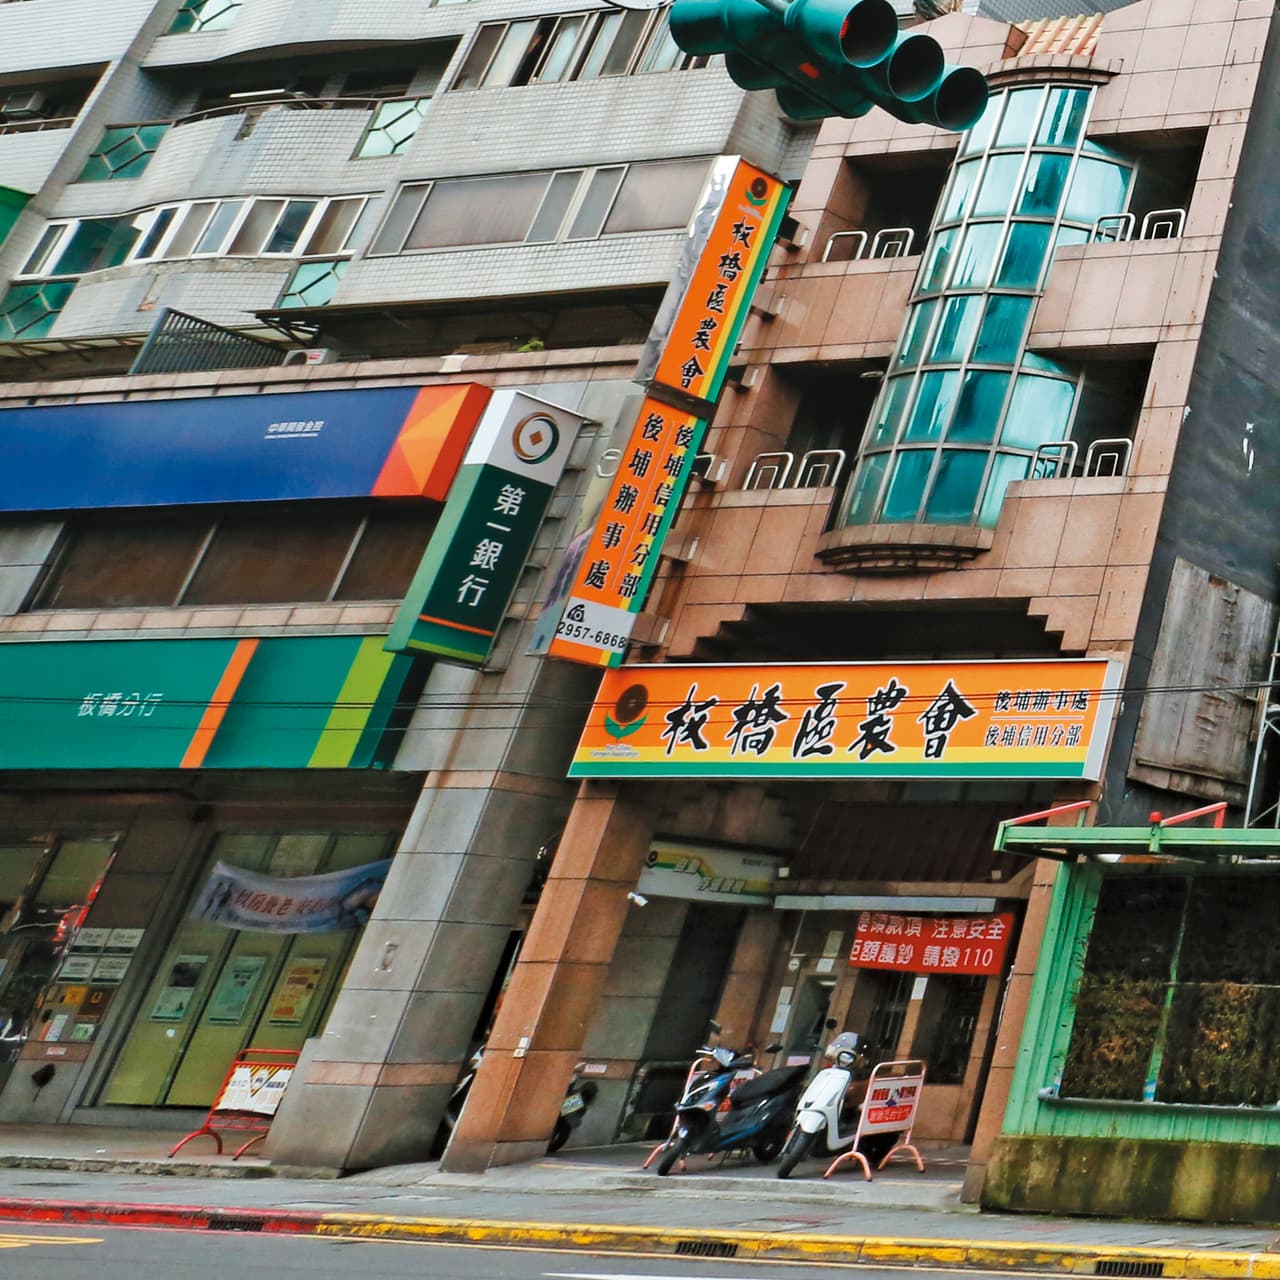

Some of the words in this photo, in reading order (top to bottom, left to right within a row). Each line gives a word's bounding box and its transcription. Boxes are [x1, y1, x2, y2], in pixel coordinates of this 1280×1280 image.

[680, 216, 754, 389] 板橋區農會
[583, 412, 664, 590] 後埔辦事處
[617, 424, 694, 599] 後埔信用分部
[456, 484, 526, 607] 第一銀行
[556, 622, 627, 649] 2957-6868
[77, 692, 164, 717] 板橋分行
[994, 689, 1090, 711] 後埔辦事處
[661, 676, 978, 761] 板橋區農會
[985, 724, 1082, 747] 後埔信用分部
[931, 917, 1006, 940] 注意安全
[922, 945, 994, 968] 請撥110
